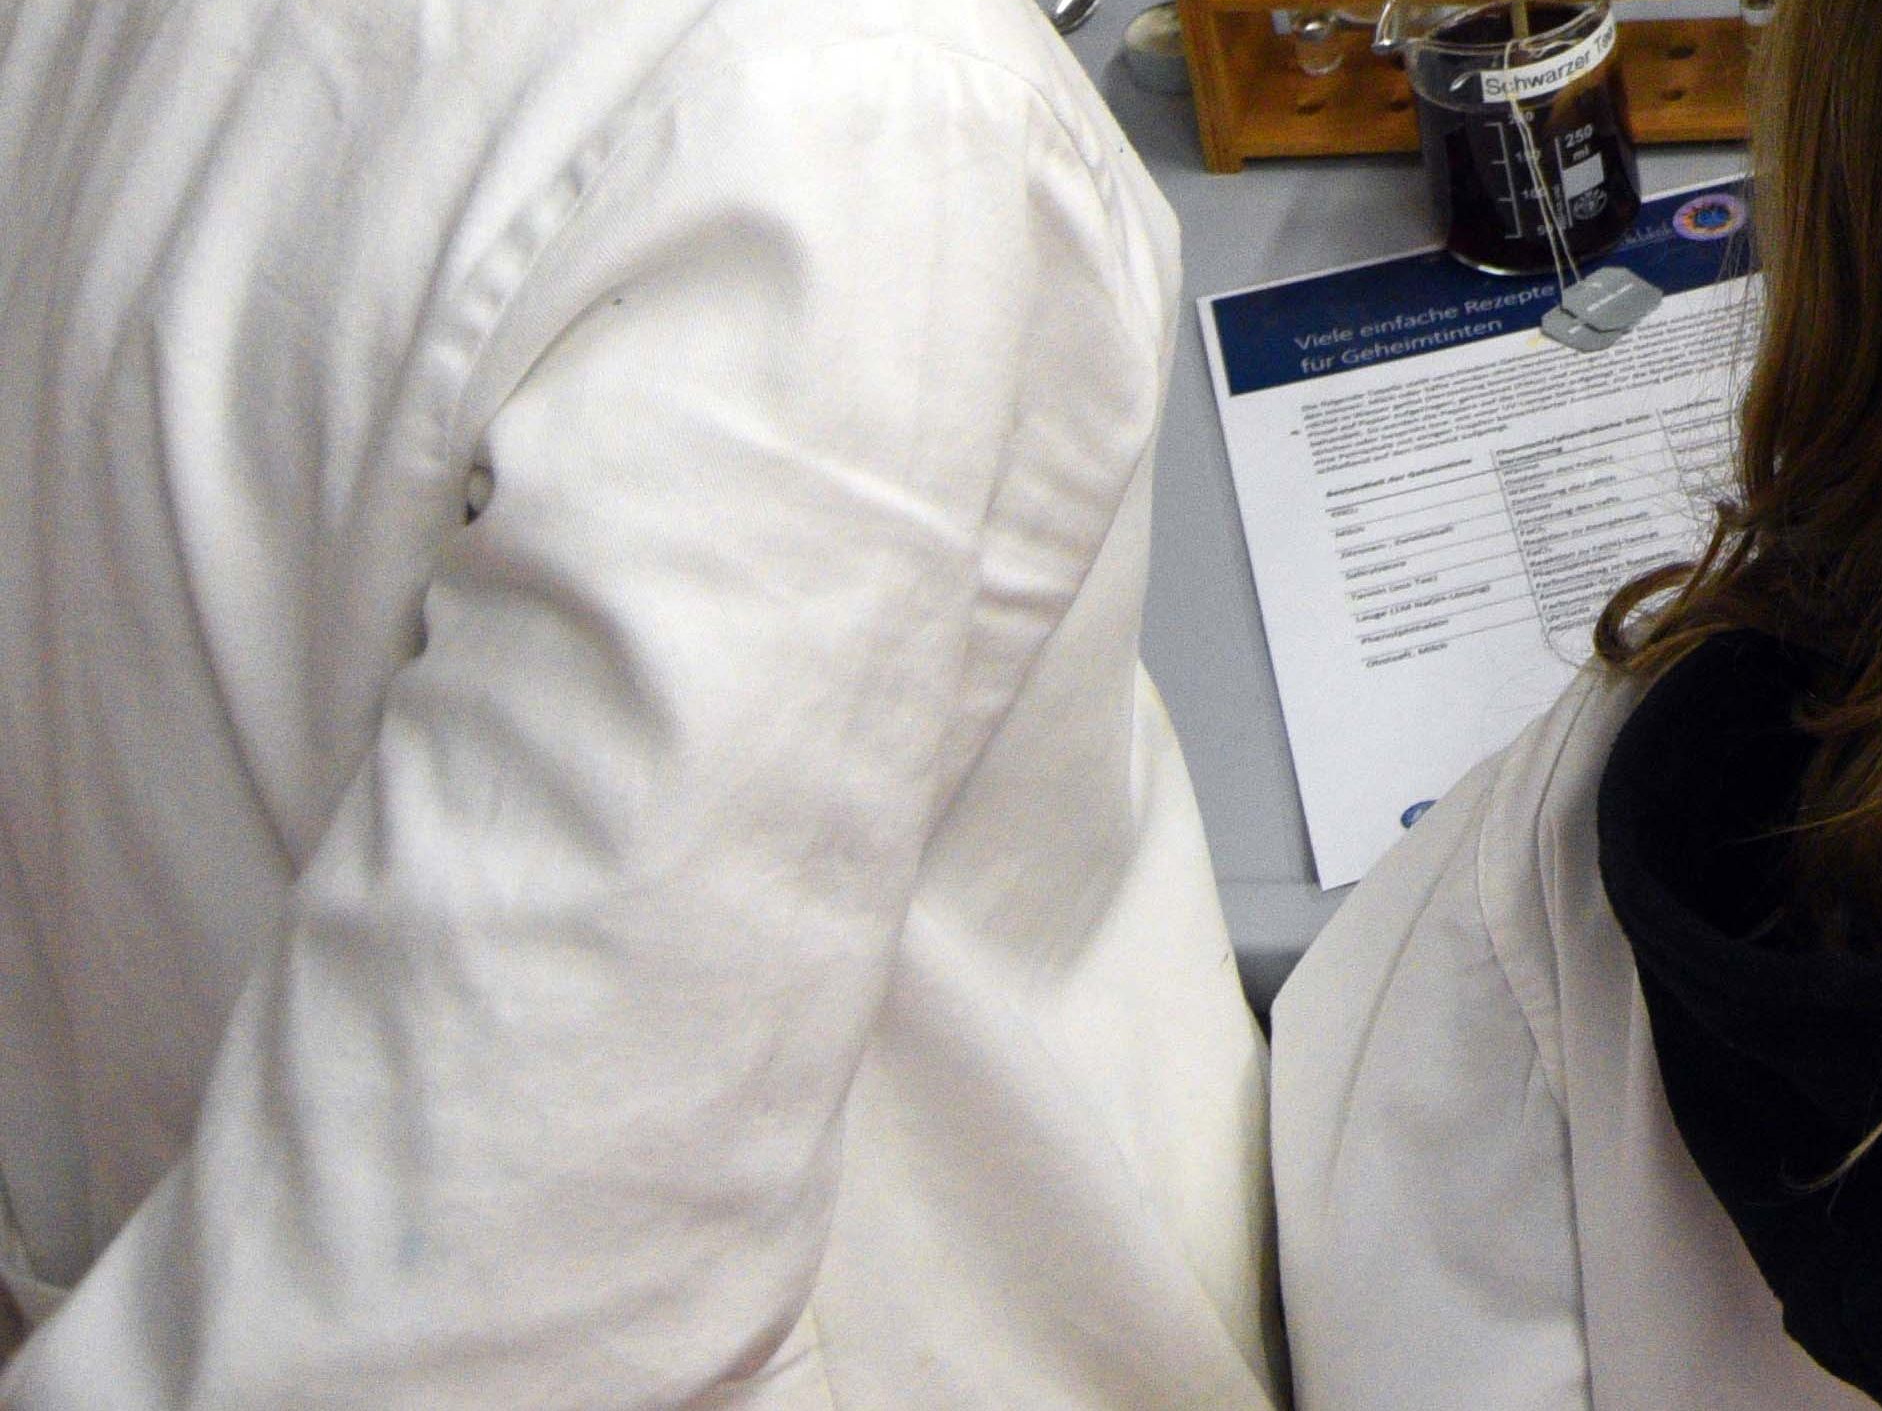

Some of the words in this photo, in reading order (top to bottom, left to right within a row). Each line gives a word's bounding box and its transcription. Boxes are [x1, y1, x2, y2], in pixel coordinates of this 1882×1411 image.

[1564, 123, 1594, 149] 250
[1293, 326, 1354, 352] Viele
[1359, 303, 1460, 338] einfache
[1464, 283, 1556, 317] Rezepte
[1301, 355, 1333, 374] für
[1339, 318, 1503, 363] Geheimtinten
